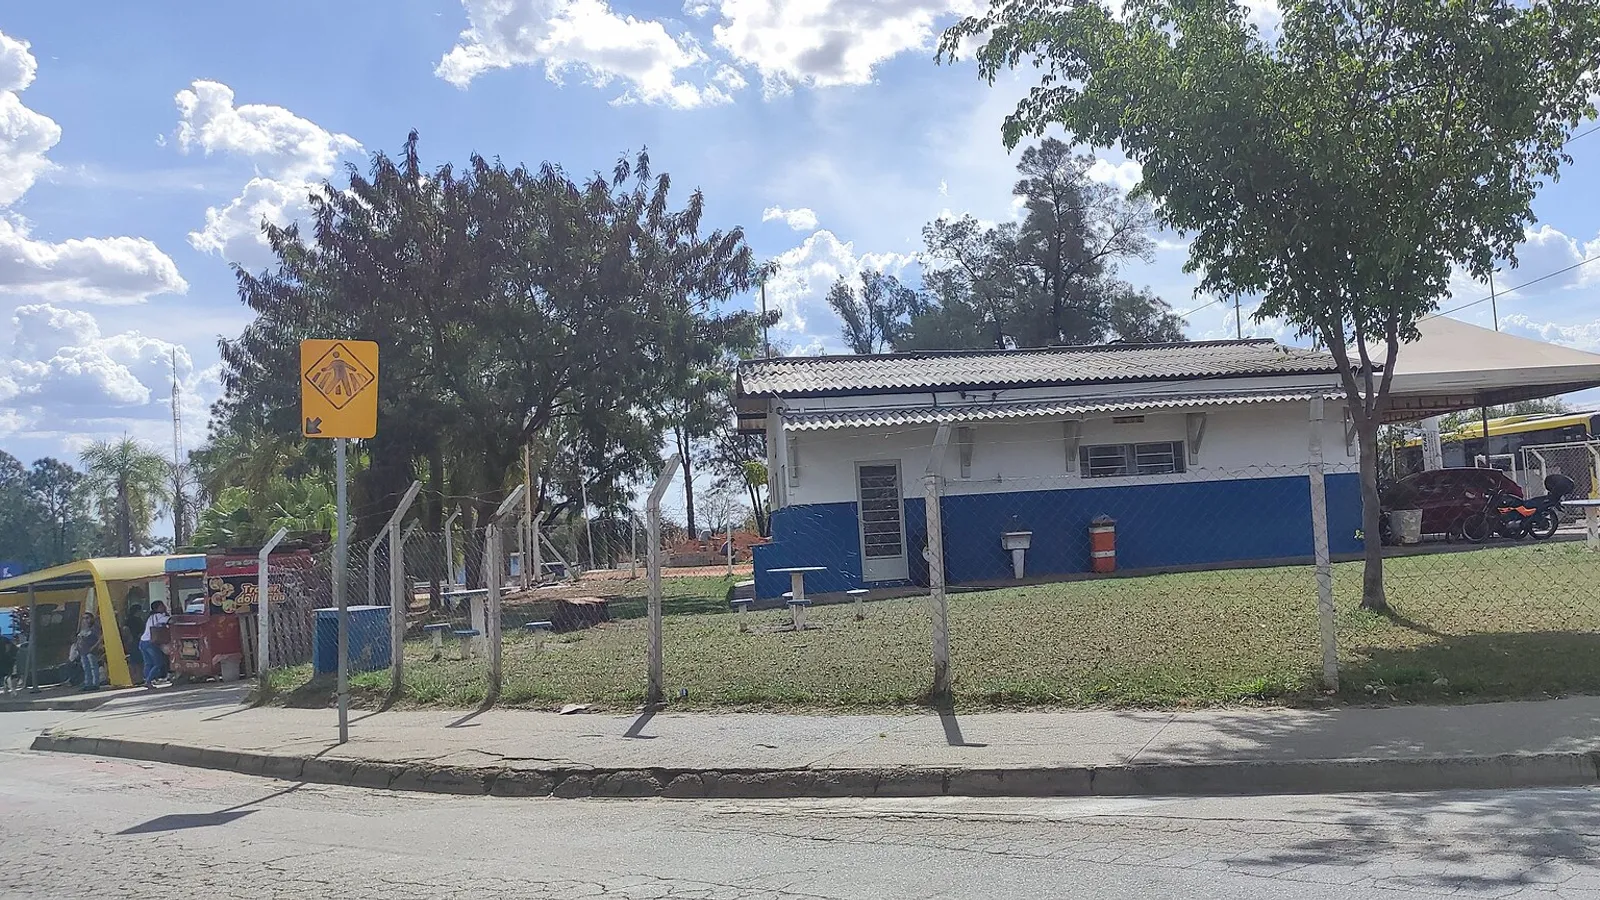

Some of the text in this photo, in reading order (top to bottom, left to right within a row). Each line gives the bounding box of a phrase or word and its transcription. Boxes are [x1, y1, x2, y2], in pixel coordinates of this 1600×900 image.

[243, 584, 278, 594] Traer
[237, 592, 285, 603] do Ião
